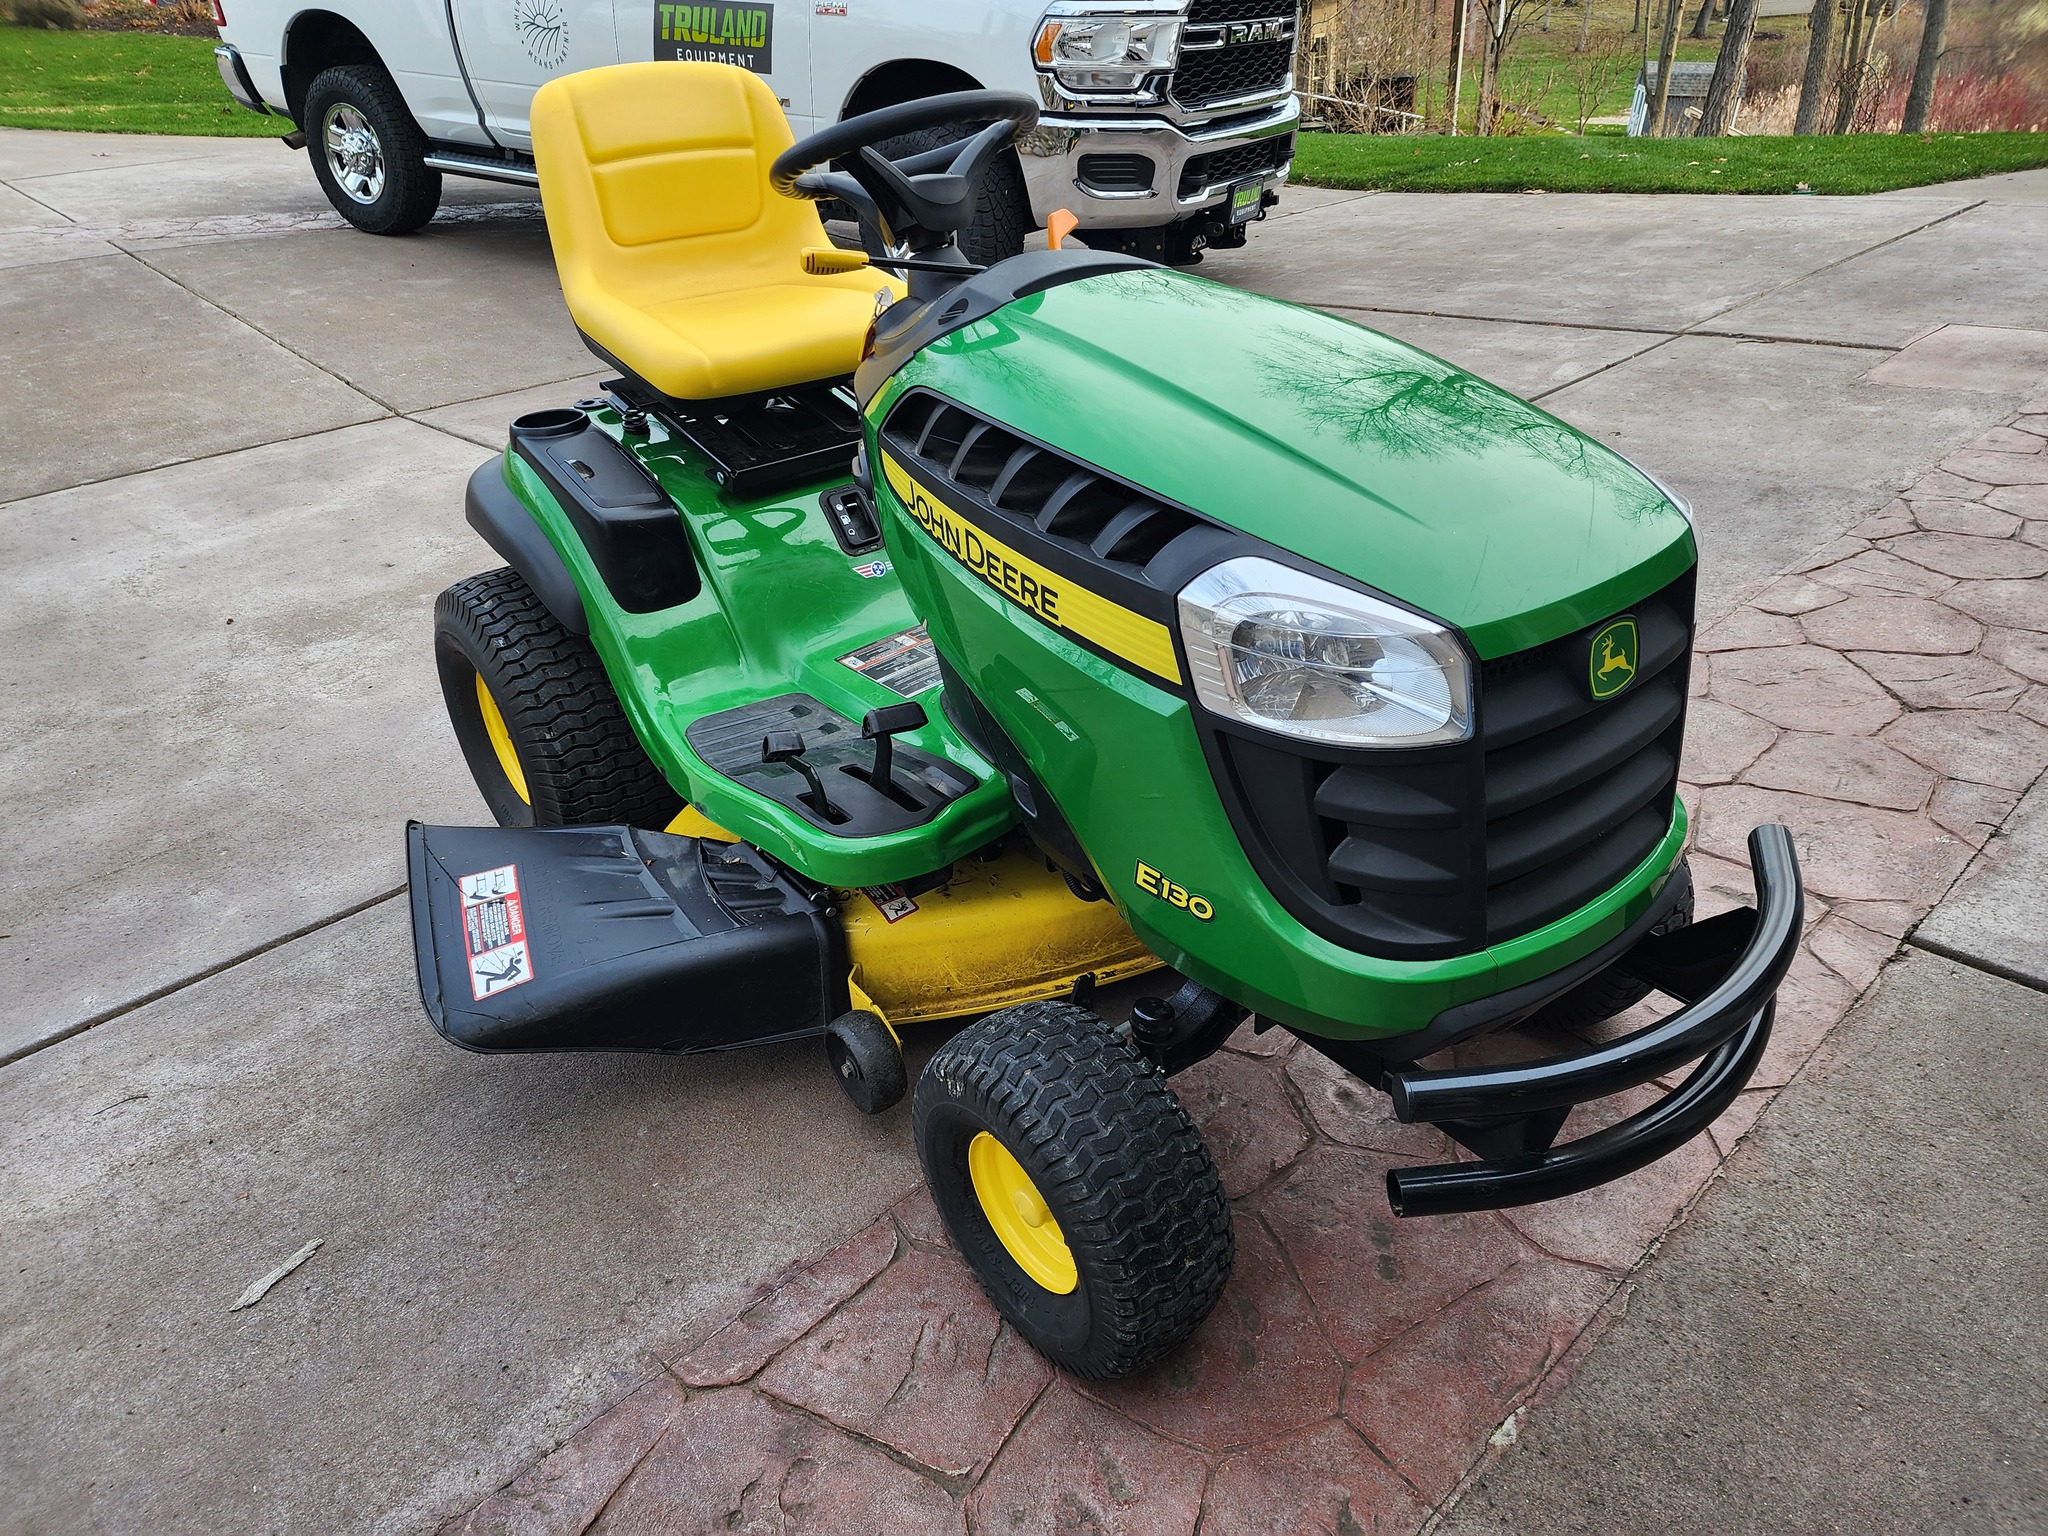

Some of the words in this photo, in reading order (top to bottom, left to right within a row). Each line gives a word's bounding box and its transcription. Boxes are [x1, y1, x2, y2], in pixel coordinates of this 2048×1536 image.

[528, 49, 553, 70] MEANS
[555, 21, 570, 67] PARTNER
[659, 4, 767, 48] TRULAND
[1230, 22, 1284, 43] RAM
[676, 48, 754, 68] EQUIPMENT
[907, 480, 962, 556] JOHN
[965, 528, 1059, 622] DEERE
[1135, 861, 1214, 920] E130
[508, 904, 522, 936] DANGER
